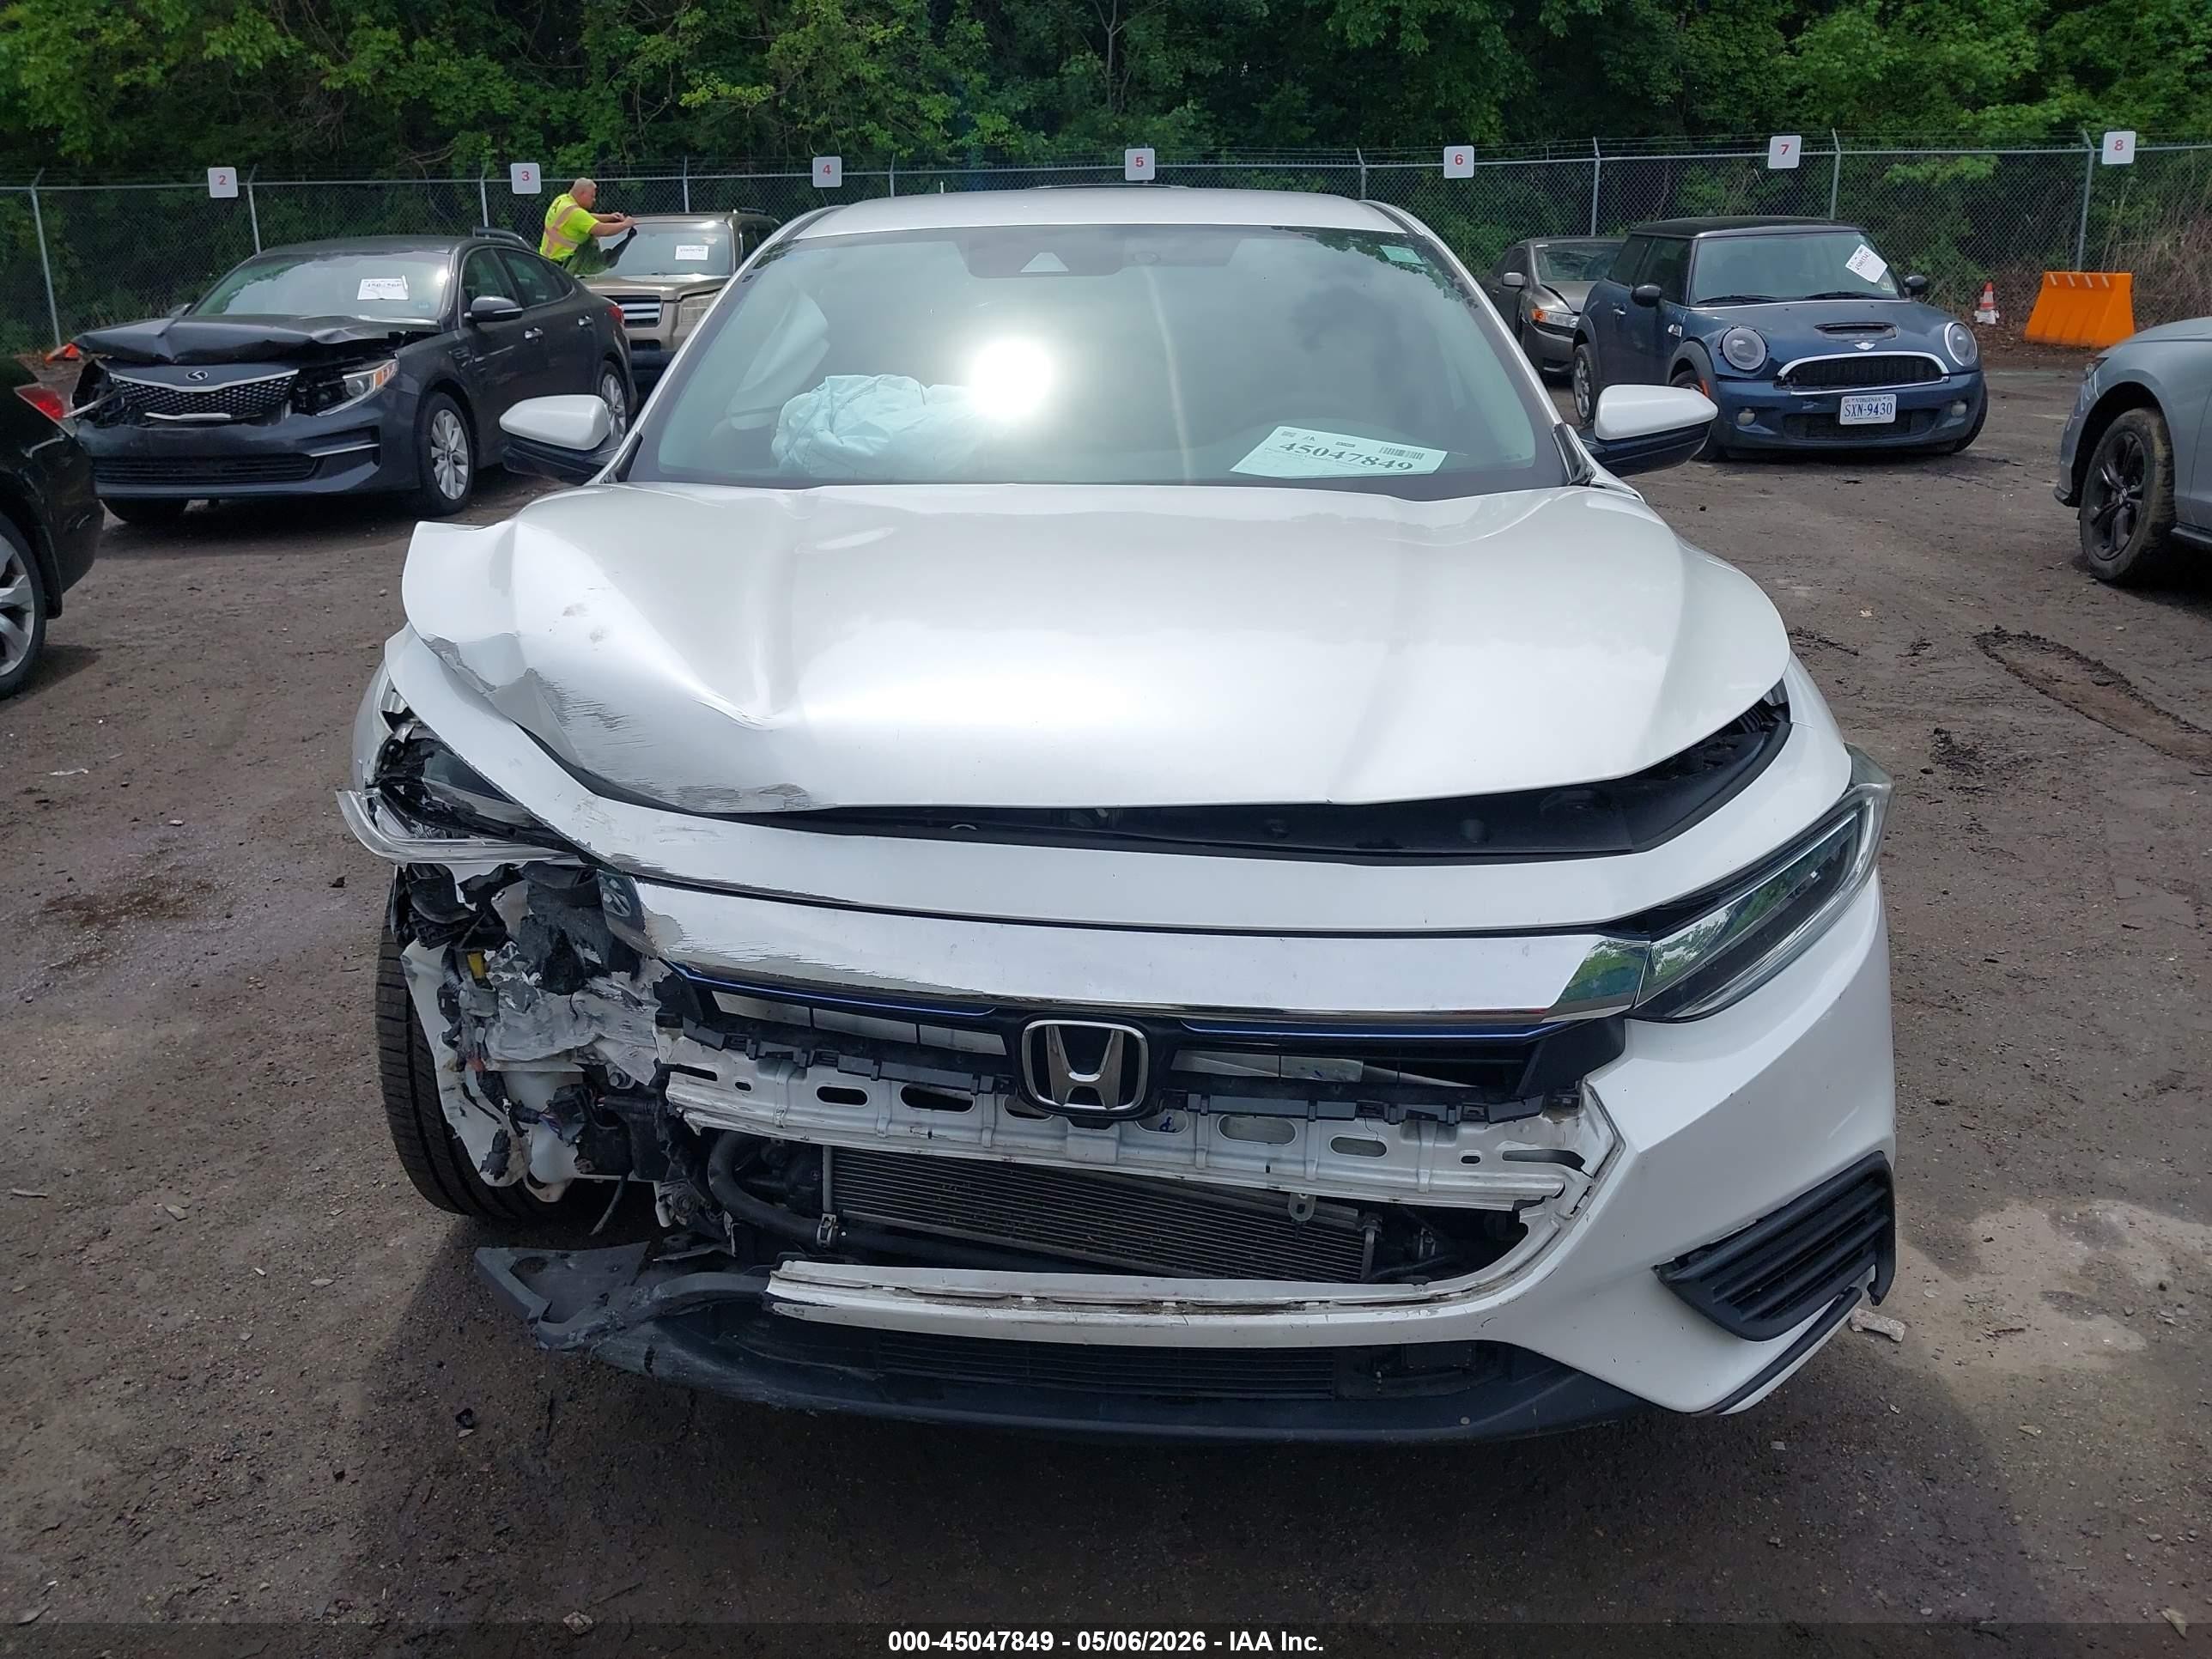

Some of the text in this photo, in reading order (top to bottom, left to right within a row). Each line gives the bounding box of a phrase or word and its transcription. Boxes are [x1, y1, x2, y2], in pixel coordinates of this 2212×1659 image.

[1780, 143, 1790, 154] 7
[2114, 140, 2124, 150] 8
[1135, 156, 1144, 167] 5
[1455, 155, 1463, 166] 6
[822, 164, 831, 175] 4
[219, 175, 227, 185] 2
[521, 172, 531, 181] 3
[1844, 402, 1893, 417] SXN-9430
[1279, 442, 1413, 470] 45047849
